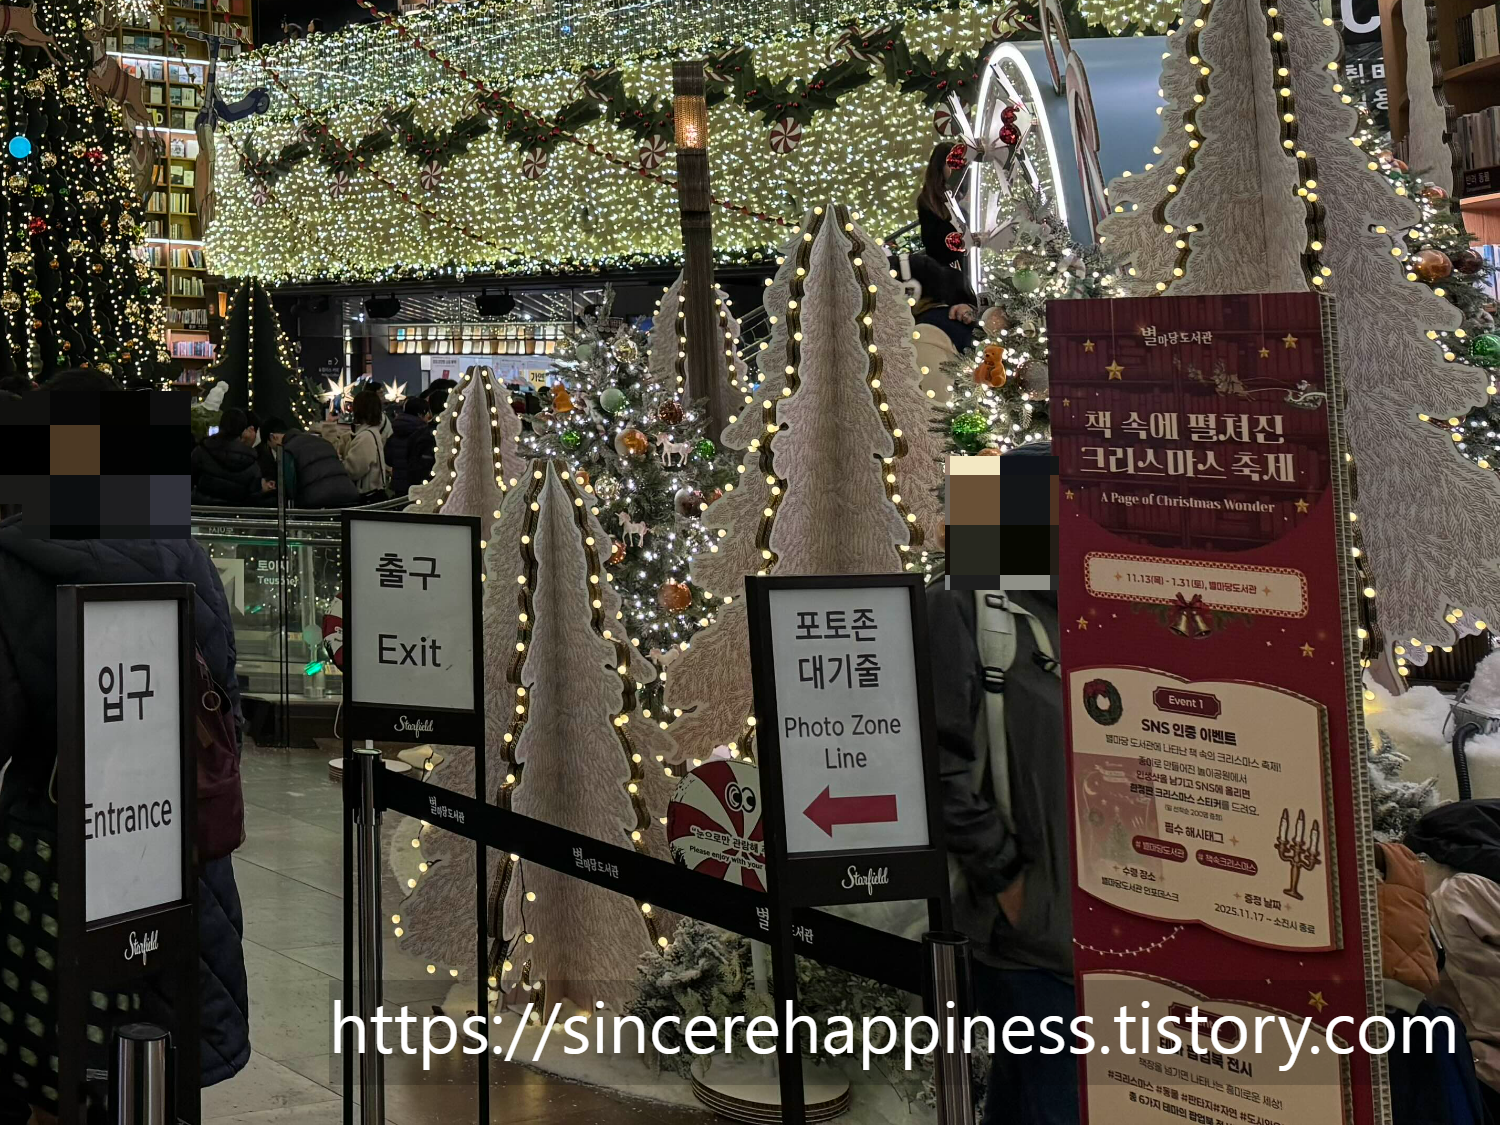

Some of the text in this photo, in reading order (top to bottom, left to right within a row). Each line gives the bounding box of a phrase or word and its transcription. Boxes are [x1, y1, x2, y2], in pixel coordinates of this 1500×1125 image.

[1140, 325, 1213, 347] 별마당도서관
[1084, 410, 1285, 444] 책 속에 펼쳐진
[1080, 446, 1296, 483] 크리스마스 축제
[1100, 492, 1275, 513] A Page of Christmas Wonder
[375, 552, 441, 591] 출구
[1209, 581, 1257, 595] 별마당도서관
[795, 608, 878, 642] 포토존
[378, 634, 442, 668] Exit
[798, 653, 882, 690] 대기줄
[98, 662, 154, 724] 입구
[1168, 695, 1204, 710] Event 1
[393, 715, 434, 739] Starfield
[784, 714, 902, 738] Photo Zone
[1141, 718, 1238, 746] SNS 인증 이벤트
[825, 747, 868, 769] Line
[1105, 734, 1129, 747] 별마당
[1130, 737, 1162, 753] 도서관에
[1163, 743, 1187, 756] 나타난
[1189, 748, 1198, 758] 책
[1199, 750, 1216, 761] 속의
[1217, 752, 1260, 769] 크리스마스
[1136, 769, 1251, 800] 인생샷을 남기고 SNS에 올리면
[1163, 760, 1196, 775] 만들어진
[1197, 766, 1248, 784] 놀이공원에서
[428, 795, 466, 824] 별마당도서관
[1155, 787, 1195, 804] 크리스마스
[1196, 795, 1230, 811] 스티커를
[1231, 802, 1260, 817] 드려요.
[84, 798, 173, 841] Entrance
[1164, 821, 1225, 844] 필수 해시태그
[689, 845, 763, 870] Please enjoy with your
[732, 837, 759, 853] 관람해
[572, 847, 620, 879] 별마당도서관
[1139, 869, 1156, 882] 장소
[841, 865, 889, 896] Starfield
[1143, 886, 1180, 903] 인포데스크
[1244, 893, 1282, 911] 증정 날짜
[1214, 903, 1264, 922] 2025.11.17
[1299, 921, 1316, 935] 종료
[124, 929, 159, 966] Starfield
[1226, 1055, 1253, 1078] 전시
[1107, 1070, 1155, 1092] #크리스마스
[1155, 1084, 1180, 1101] #동물
[1164, 1064, 1188, 1082] 넘기면
[1190, 1073, 1225, 1093] 나타나는
[1226, 1084, 1261, 1104] 흥미로운
[1262, 1094, 1284, 1111] 세상!
[1129, 1090, 1138, 1103] 총
[1138, 1094, 1161, 1111] 6가지
[1162, 1101, 1187, 1119] 테마의
